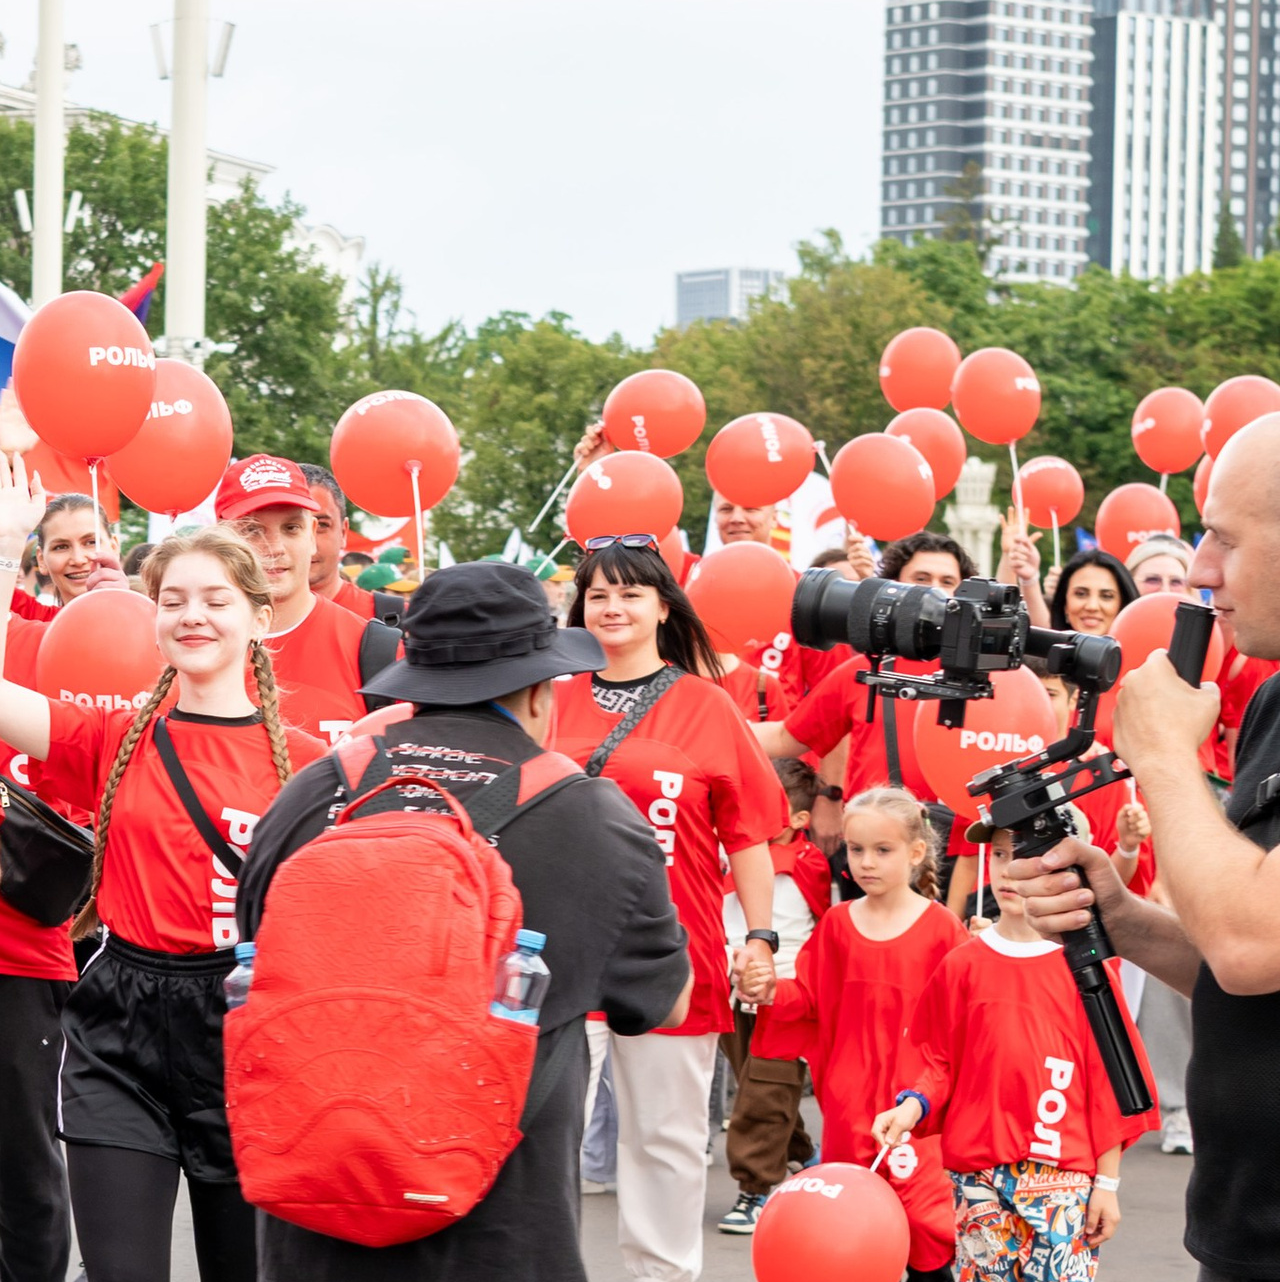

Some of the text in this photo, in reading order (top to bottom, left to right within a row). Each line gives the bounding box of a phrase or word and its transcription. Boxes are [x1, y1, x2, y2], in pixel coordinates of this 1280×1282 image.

[146, 399, 193, 421] ЛЬФ
[631, 415, 651, 453] РОЛ
[960, 730, 1045, 754] РОЛЬФ
[648, 770, 684, 867] РОЛ
[211, 806, 261, 952] РЛЬ
[1027, 1055, 1075, 1167] РОЛ
